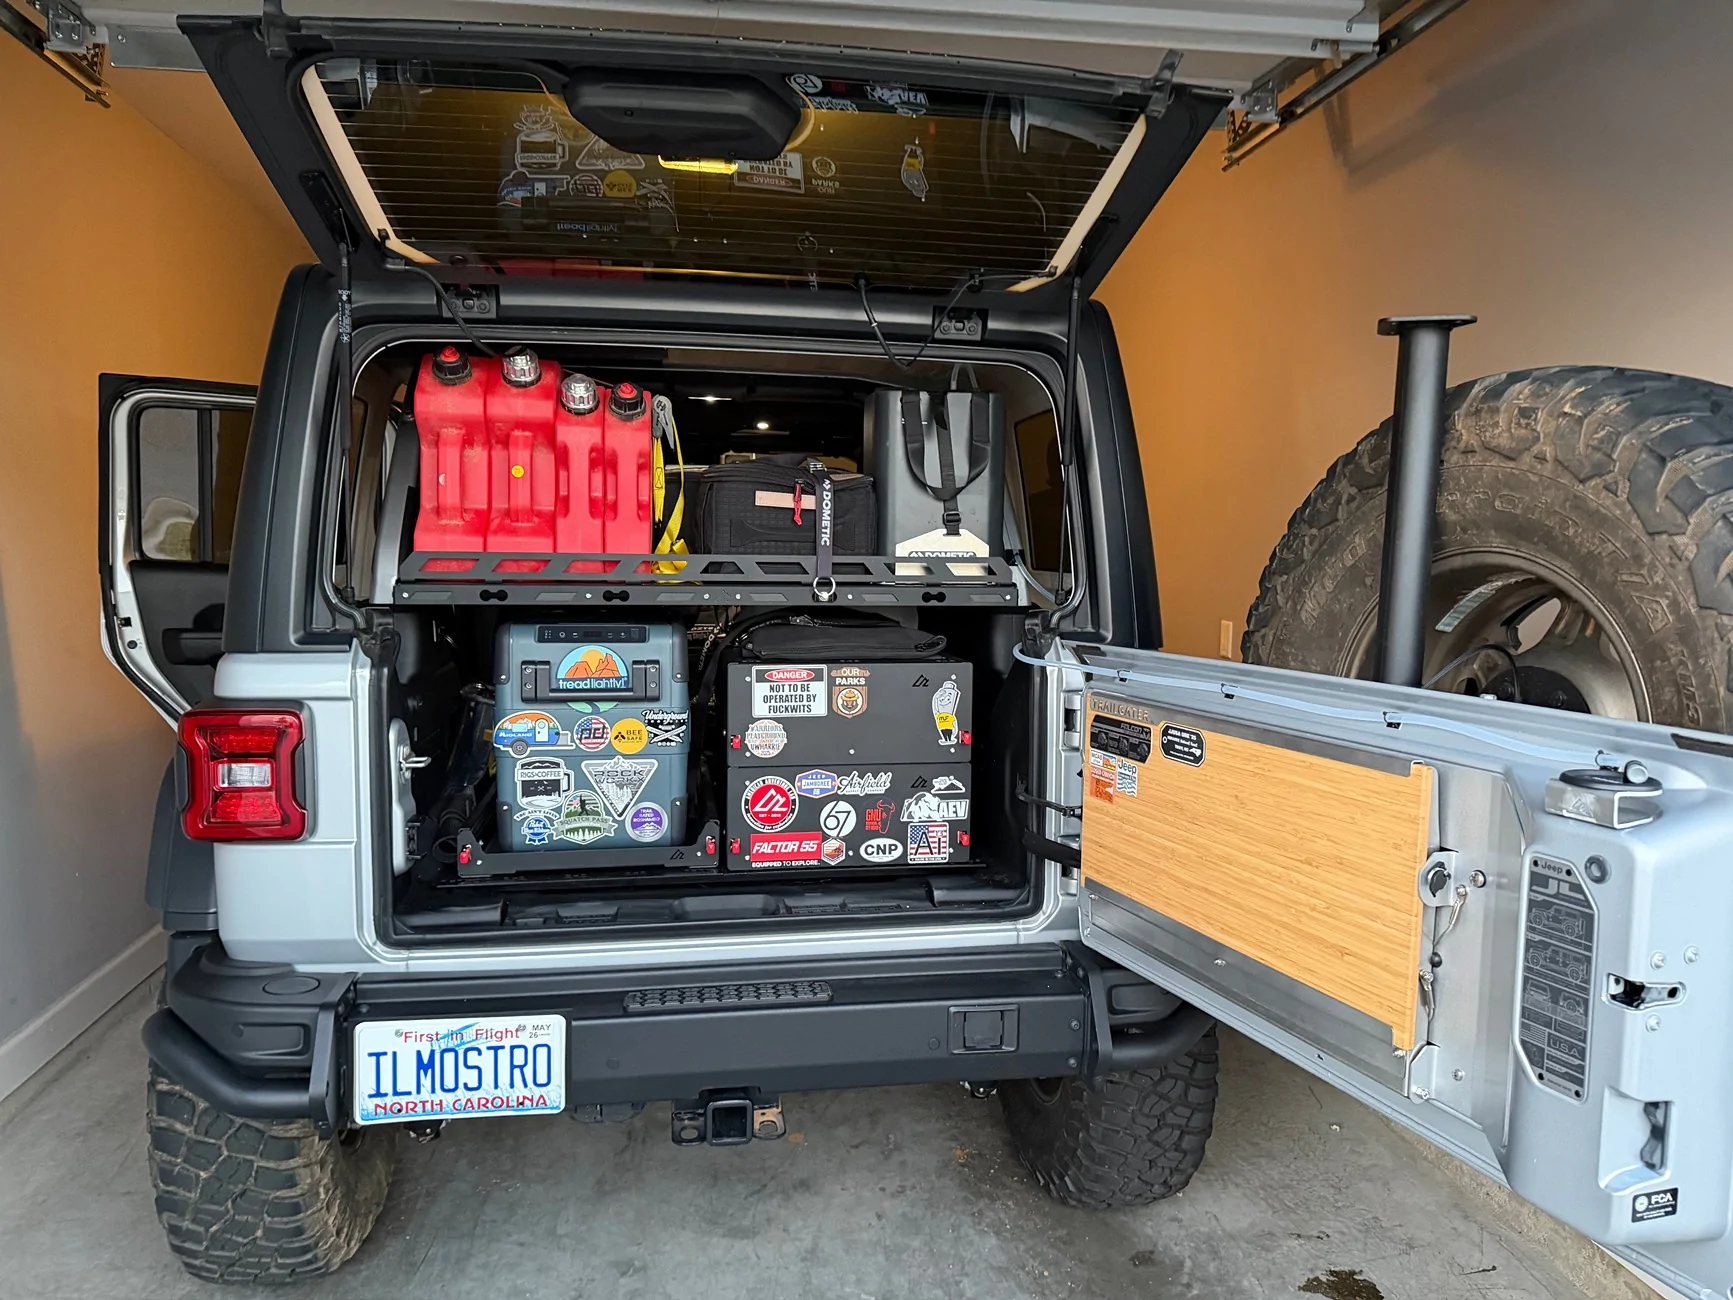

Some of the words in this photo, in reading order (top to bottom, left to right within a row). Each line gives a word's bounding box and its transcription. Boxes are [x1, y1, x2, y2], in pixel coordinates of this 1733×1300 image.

[821, 491, 832, 546] DOMETIC
[772, 671, 807, 679] DANGER
[841, 668, 860, 676] OUR
[559, 679, 590, 689] tread
[835, 677, 866, 685] PARKS
[769, 683, 786, 693] NOT
[787, 683, 798, 692] TO
[800, 683, 811, 692] BE
[762, 694, 804, 704] OPERATED
[806, 694, 817, 702] BY
[768, 704, 812, 714] FUCKWITS
[1091, 698, 1149, 721] TRAILGATER
[642, 710, 689, 725] Underground
[749, 724, 783, 732] WARRIORS
[1120, 722, 1143, 734] FALCON
[750, 743, 781, 751] UWHARRIE
[594, 769, 645, 777] ROCK
[1118, 759, 1137, 775] Jeep
[838, 771, 892, 796] Airfield
[865, 809, 881, 822] GNU
[940, 801, 967, 818] AEV
[559, 816, 591, 826] SQUATCH
[823, 800, 852, 837] 67
[752, 842, 800, 854] FACTOR
[800, 840, 820, 852] 55
[864, 844, 898, 855] CNP
[1541, 861, 1563, 875] Jeep
[1531, 877, 1586, 901] JL
[532, 1023, 551, 1031] MAY
[403, 1031, 440, 1043] First
[450, 1030, 464, 1041] in
[474, 1026, 520, 1042] Flight
[528, 1031, 539, 1039] 26
[374, 1100, 444, 1116] NORTH
[452, 1094, 548, 1112] CAROLINA
[1650, 1192, 1673, 1205] FCA
